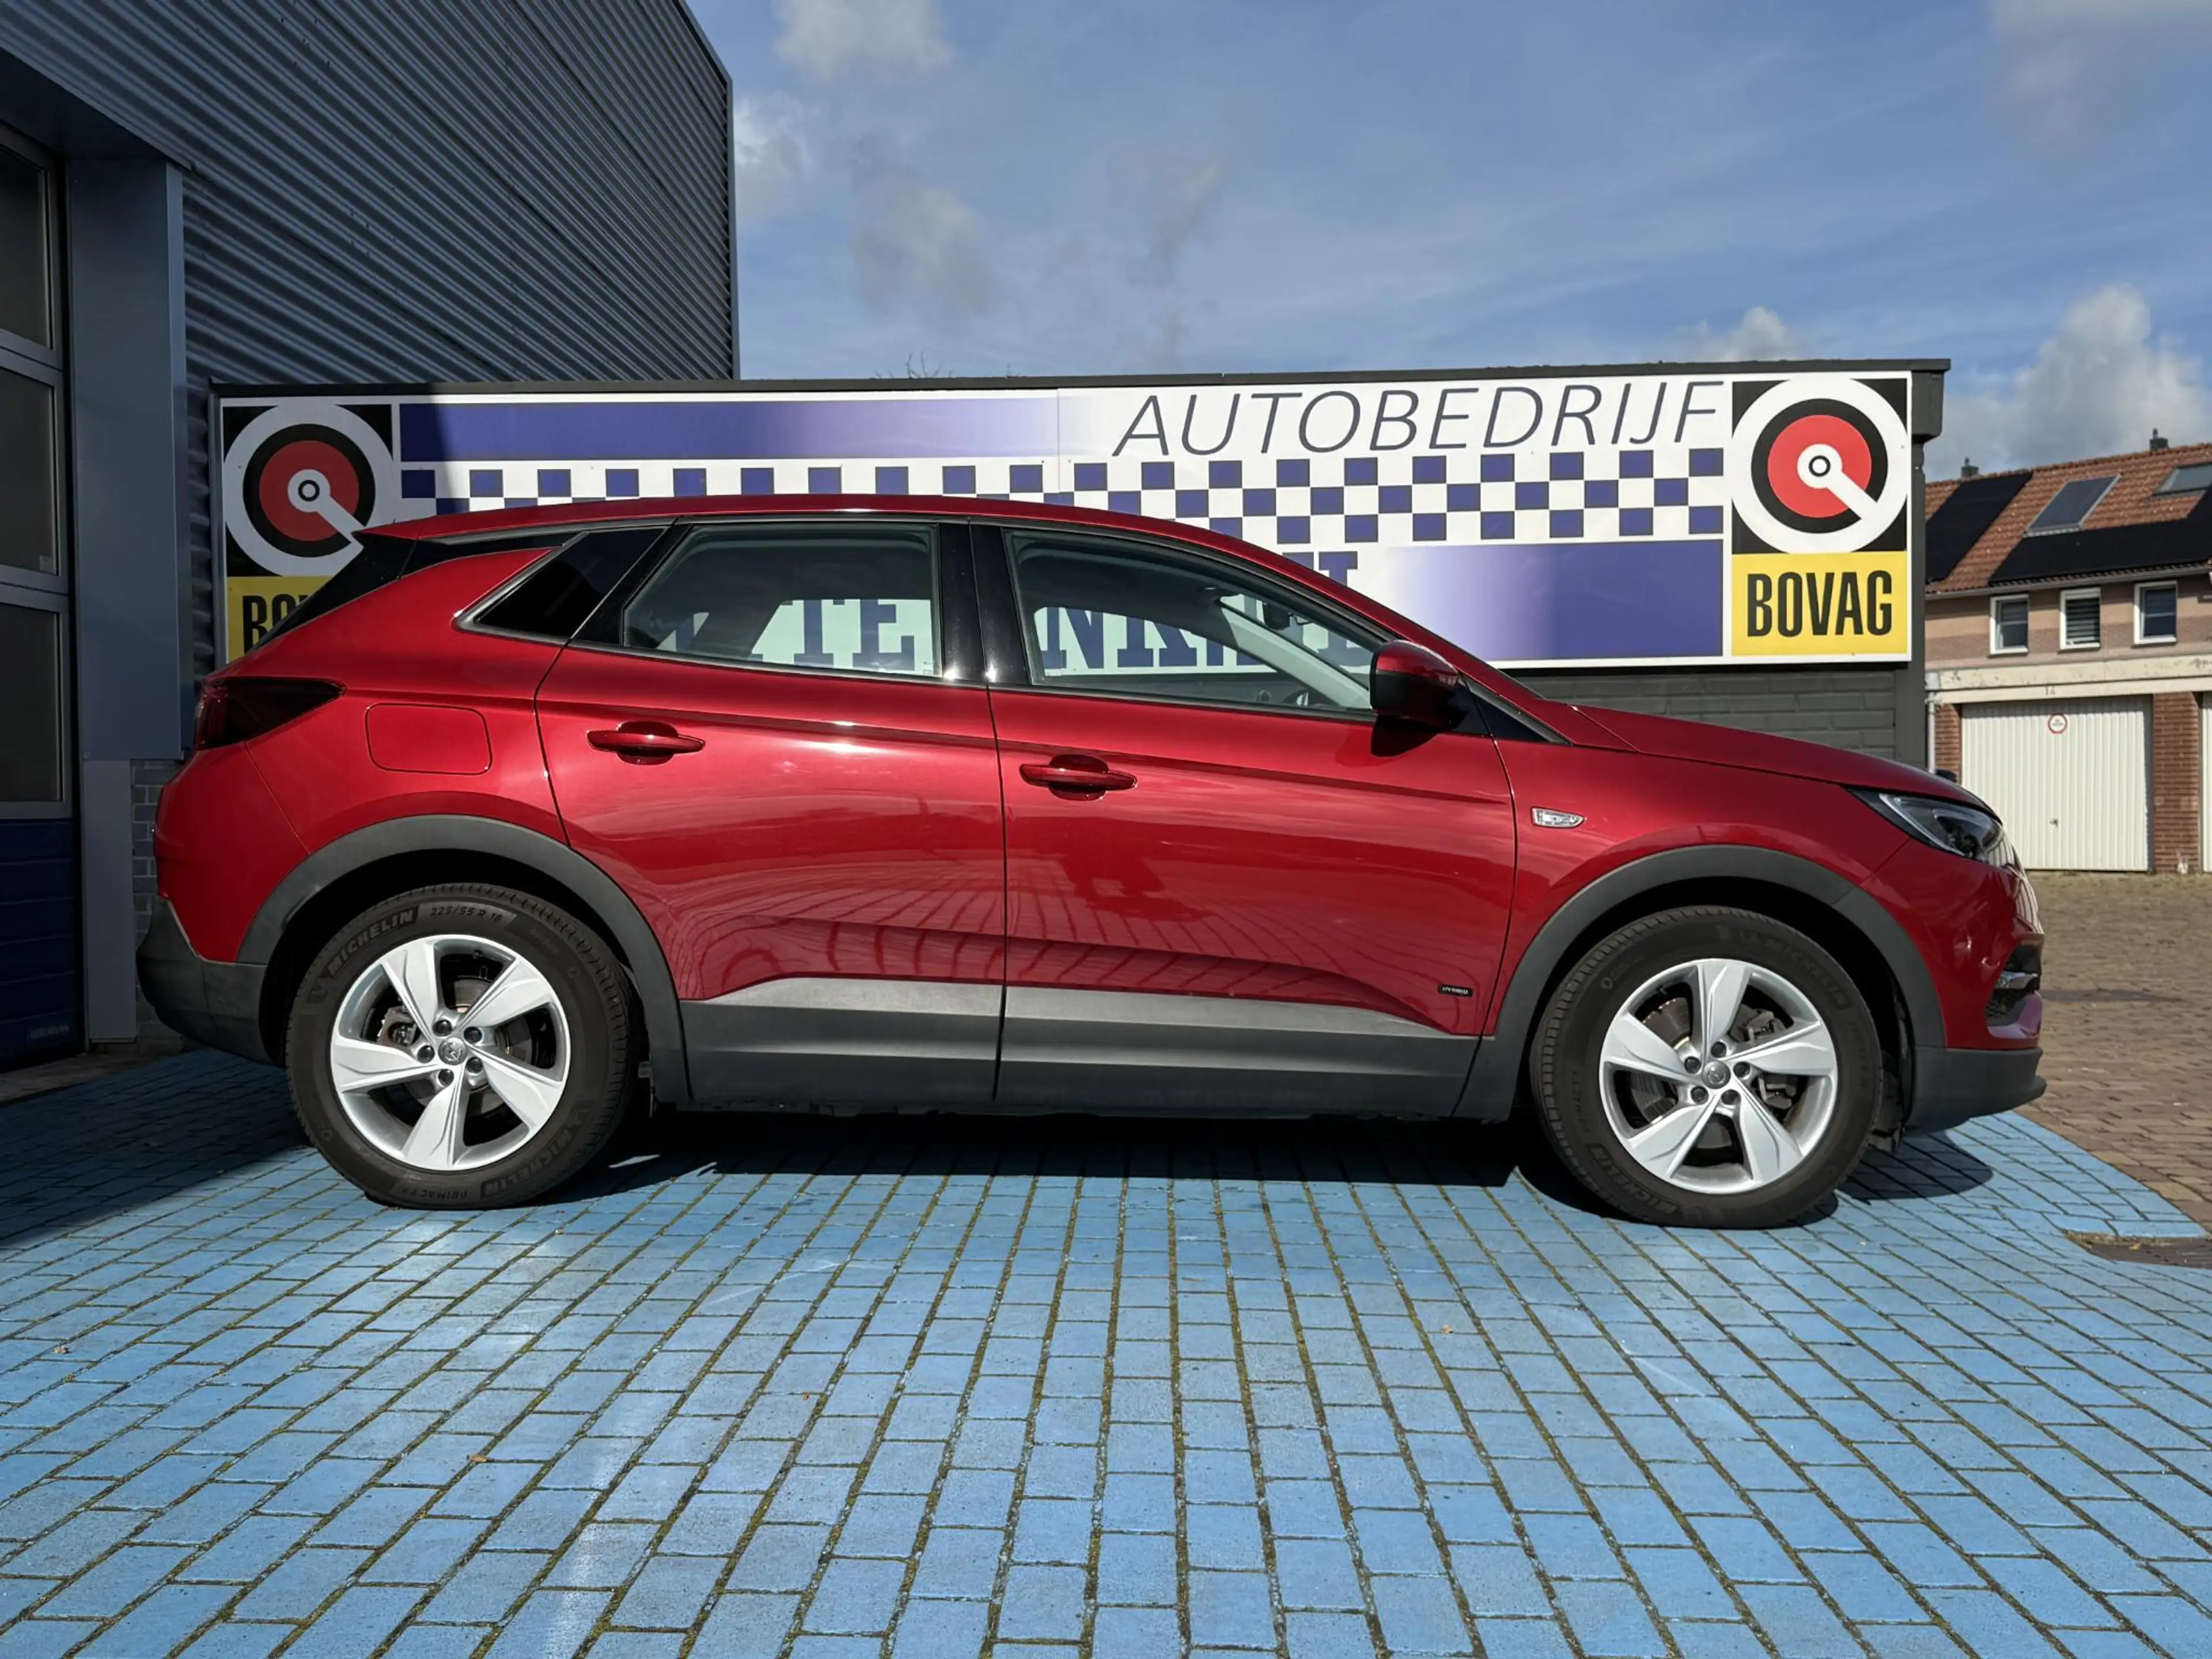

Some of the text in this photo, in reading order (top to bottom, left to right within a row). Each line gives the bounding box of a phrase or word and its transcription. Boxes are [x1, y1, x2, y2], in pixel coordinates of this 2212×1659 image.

[1112, 381, 1724, 457] AUTOBEDRIJF
[1747, 570, 1892, 637] BOVAG
[328, 908, 414, 975] MICHELIN
[430, 905, 473, 918] 225/55
[476, 909, 486, 919] R
[485, 1127, 575, 1196] MICHELIN
[1588, 1146, 1680, 1213] MICHELIN
